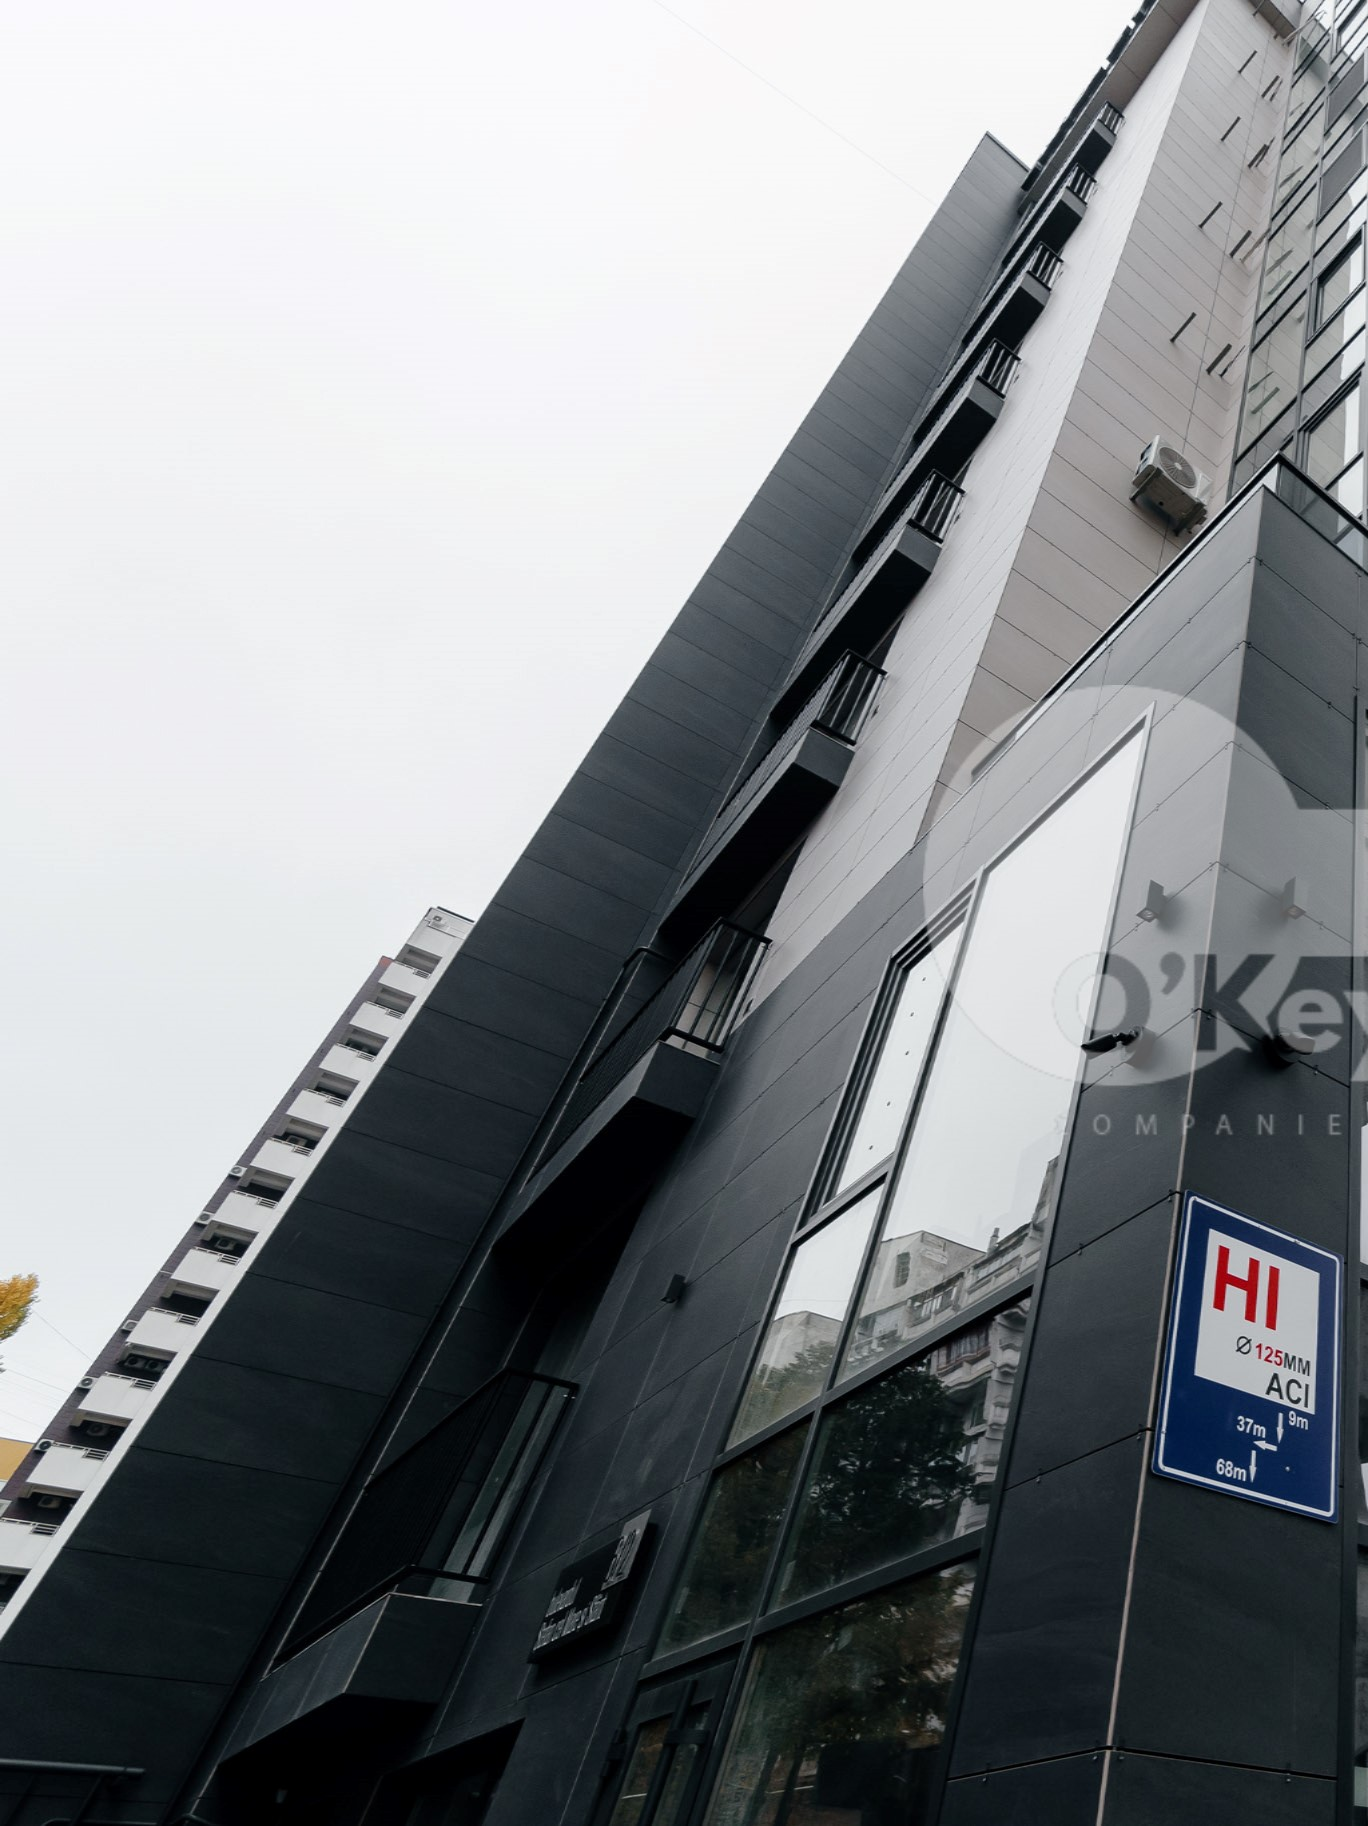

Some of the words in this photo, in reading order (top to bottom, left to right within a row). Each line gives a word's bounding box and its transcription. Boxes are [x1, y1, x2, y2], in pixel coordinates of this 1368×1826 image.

[1212, 1244, 1280, 1332] HI
[1255, 1342, 1311, 1377] 125MM
[1264, 1372, 1310, 1409] ACI
[1236, 1415, 1266, 1439] 37m
[1287, 1410, 1309, 1431] 9m
[1215, 1457, 1247, 1482] 68m
